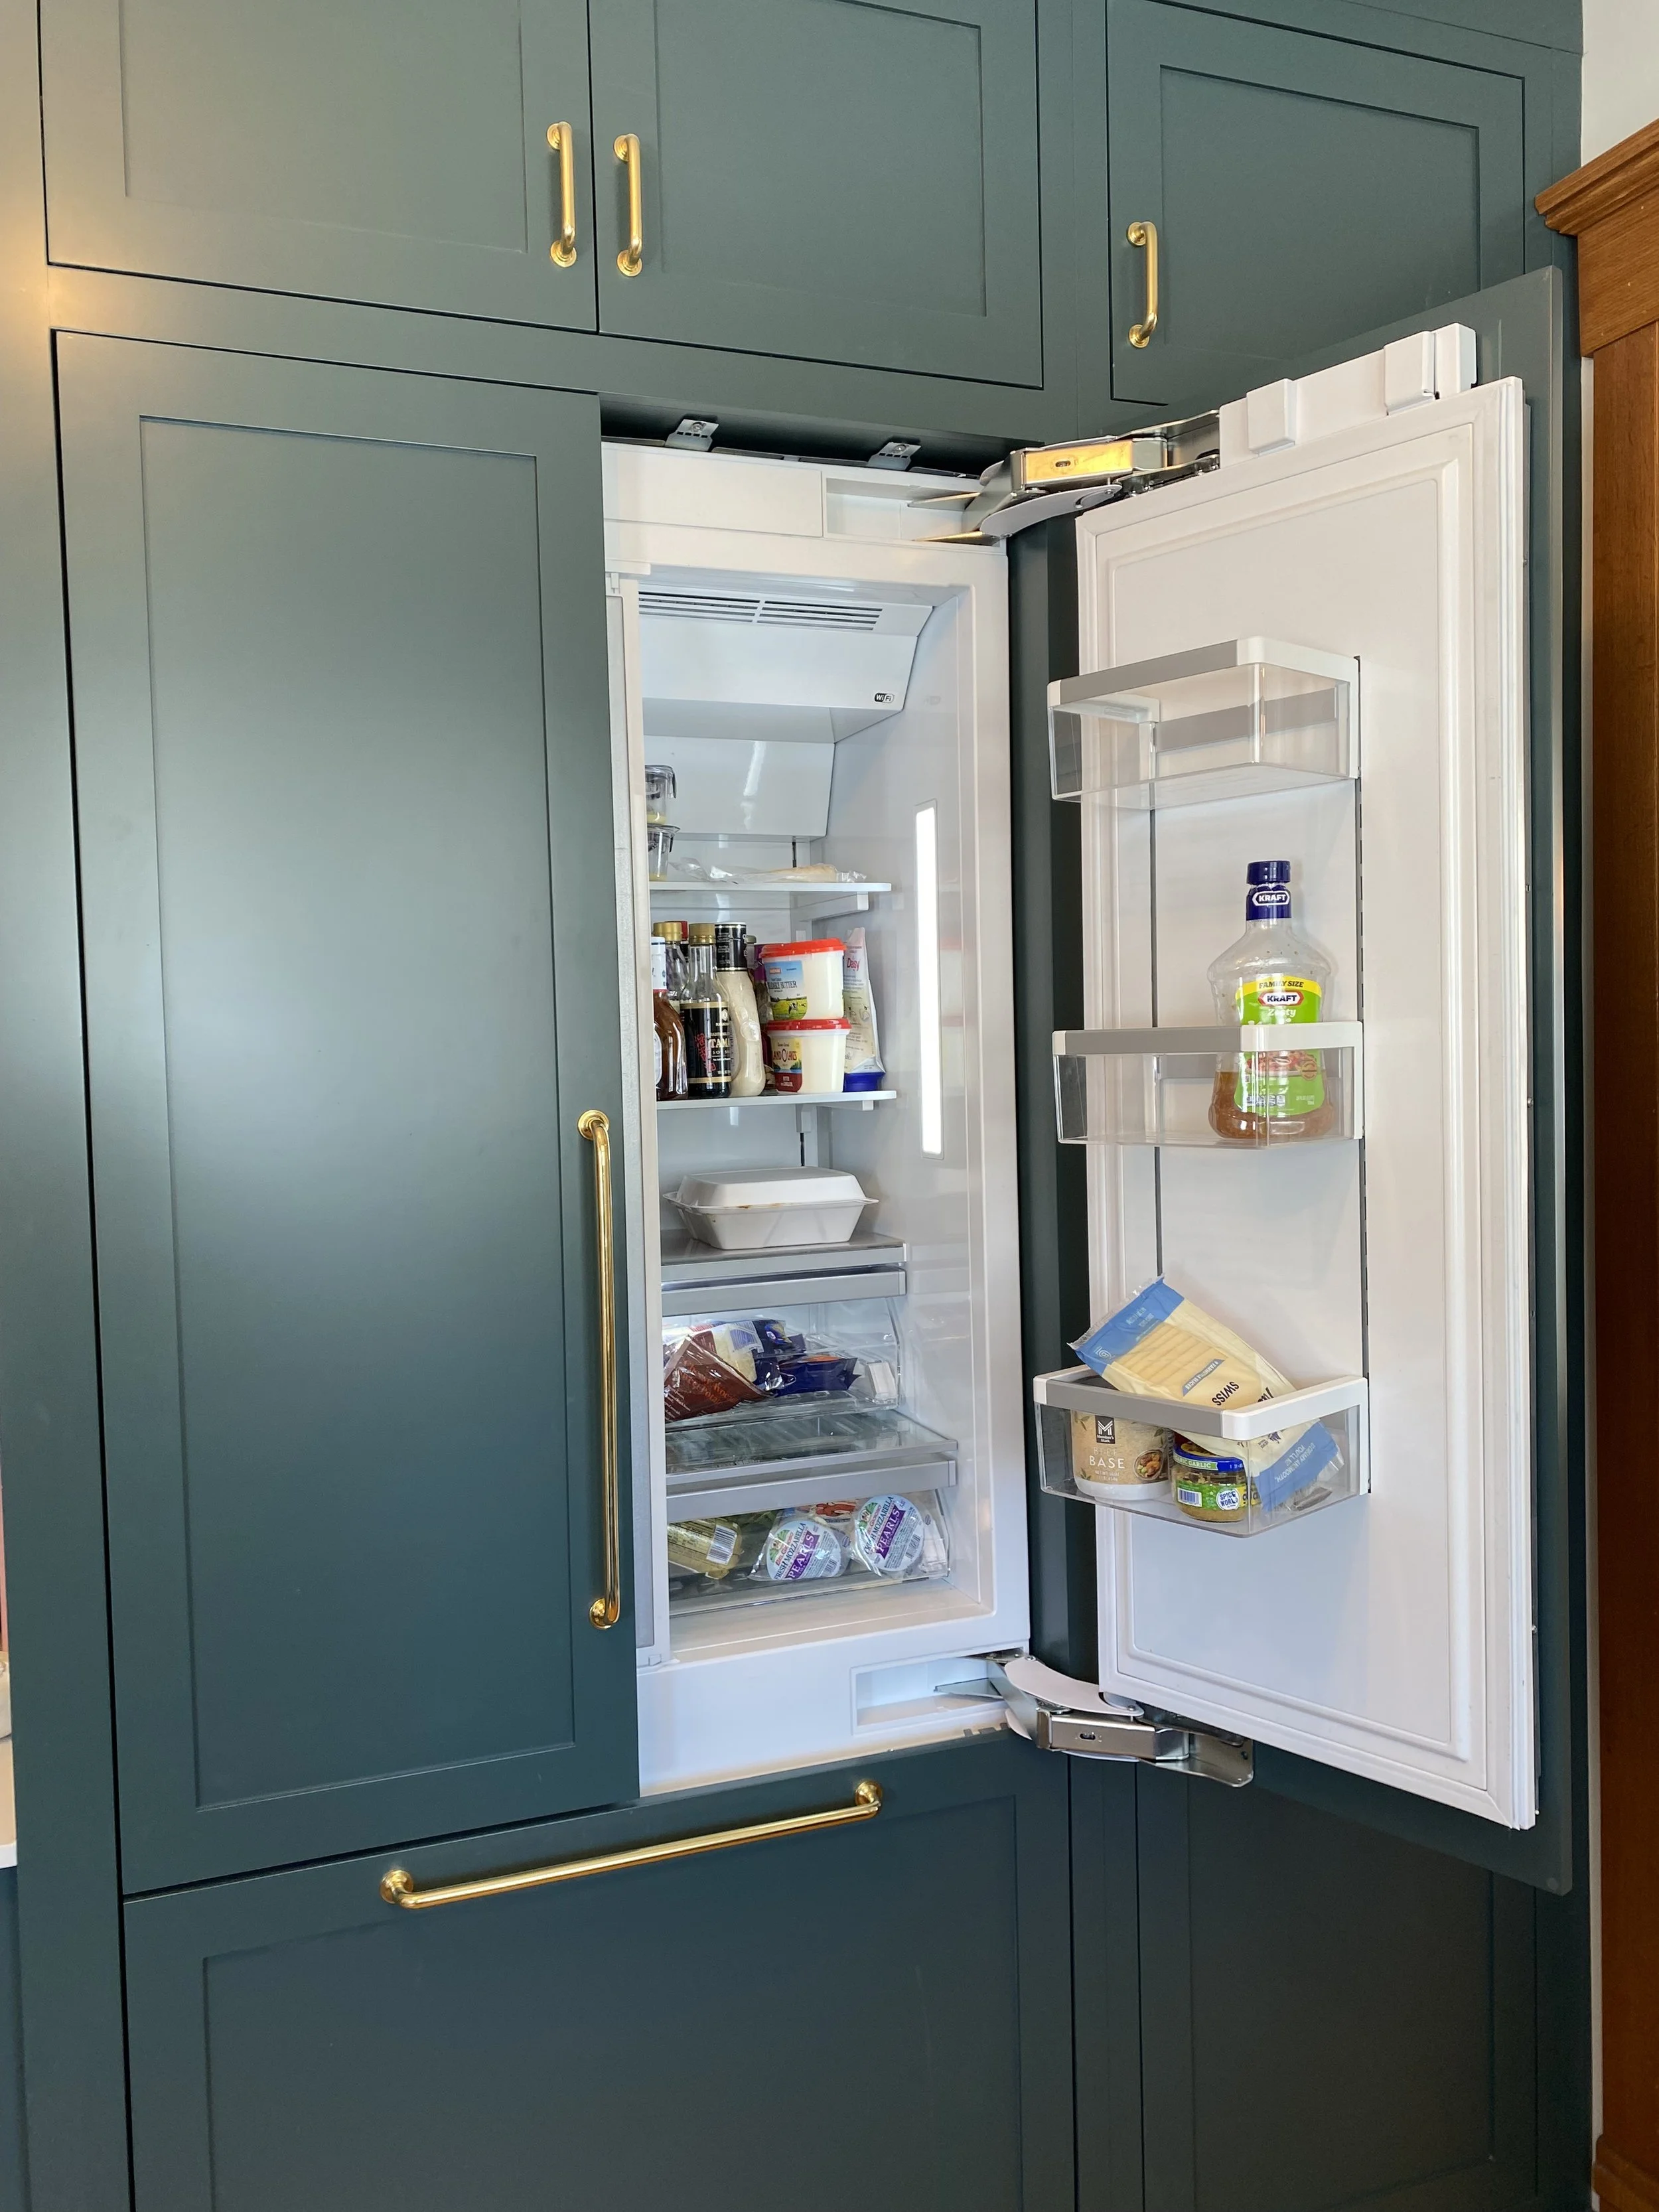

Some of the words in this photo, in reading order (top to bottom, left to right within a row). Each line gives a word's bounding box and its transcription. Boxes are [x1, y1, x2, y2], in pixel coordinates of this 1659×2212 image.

[1212, 1382, 1240, 1406] SWISS
[1089, 1455, 1125, 1469] BASE
[1220, 1491, 1236, 1499] SPICE
[873, 1496, 894, 1535] MOZZARELLA
[877, 1509, 900, 1553] PEARLS
[774, 1561, 788, 1580] FRESH
[784, 1522, 806, 1562] MOZZARELLA
